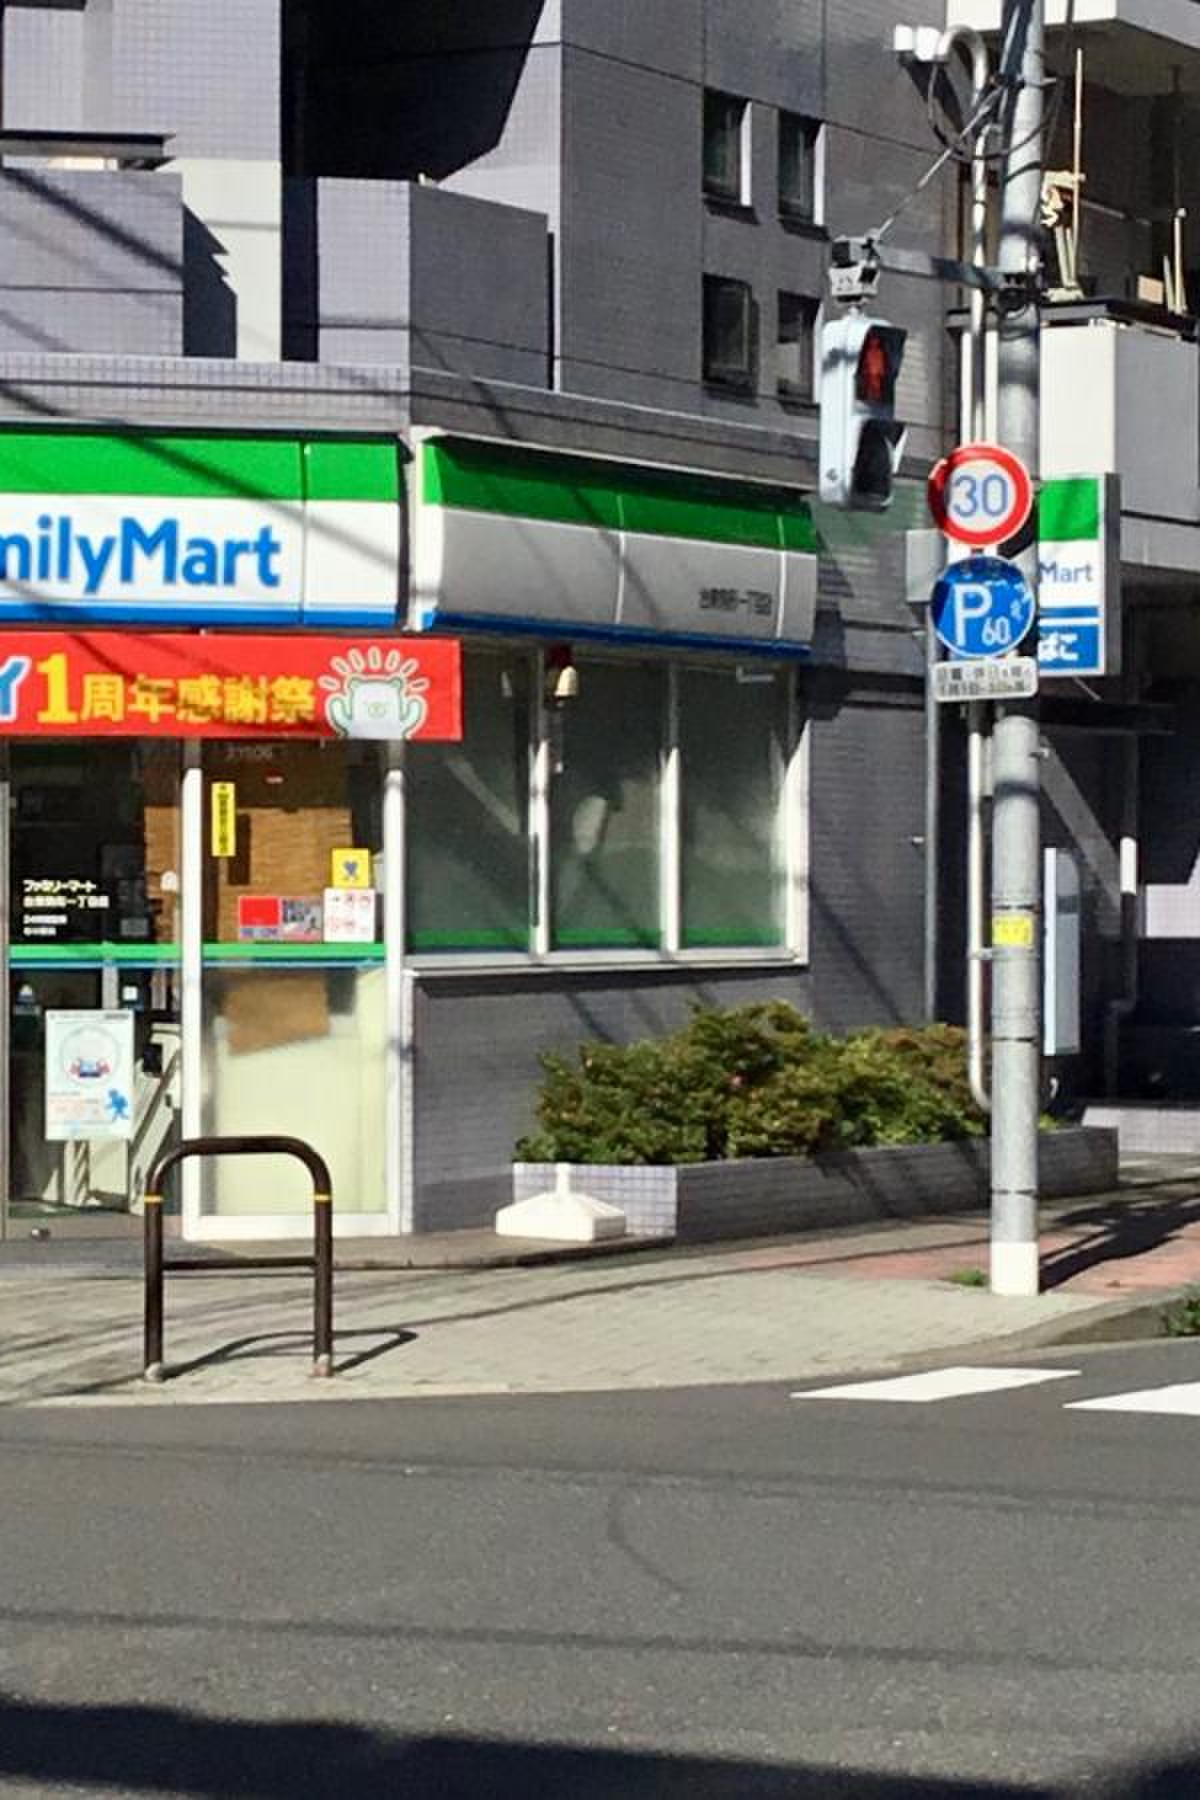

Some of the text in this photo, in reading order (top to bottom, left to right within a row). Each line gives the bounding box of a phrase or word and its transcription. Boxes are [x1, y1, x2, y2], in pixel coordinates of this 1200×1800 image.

[952, 473, 1009, 518] 30
[952, 583, 993, 647] P
[981, 616, 1012, 646] 60
[1038, 631, 1079, 662] ばこ
